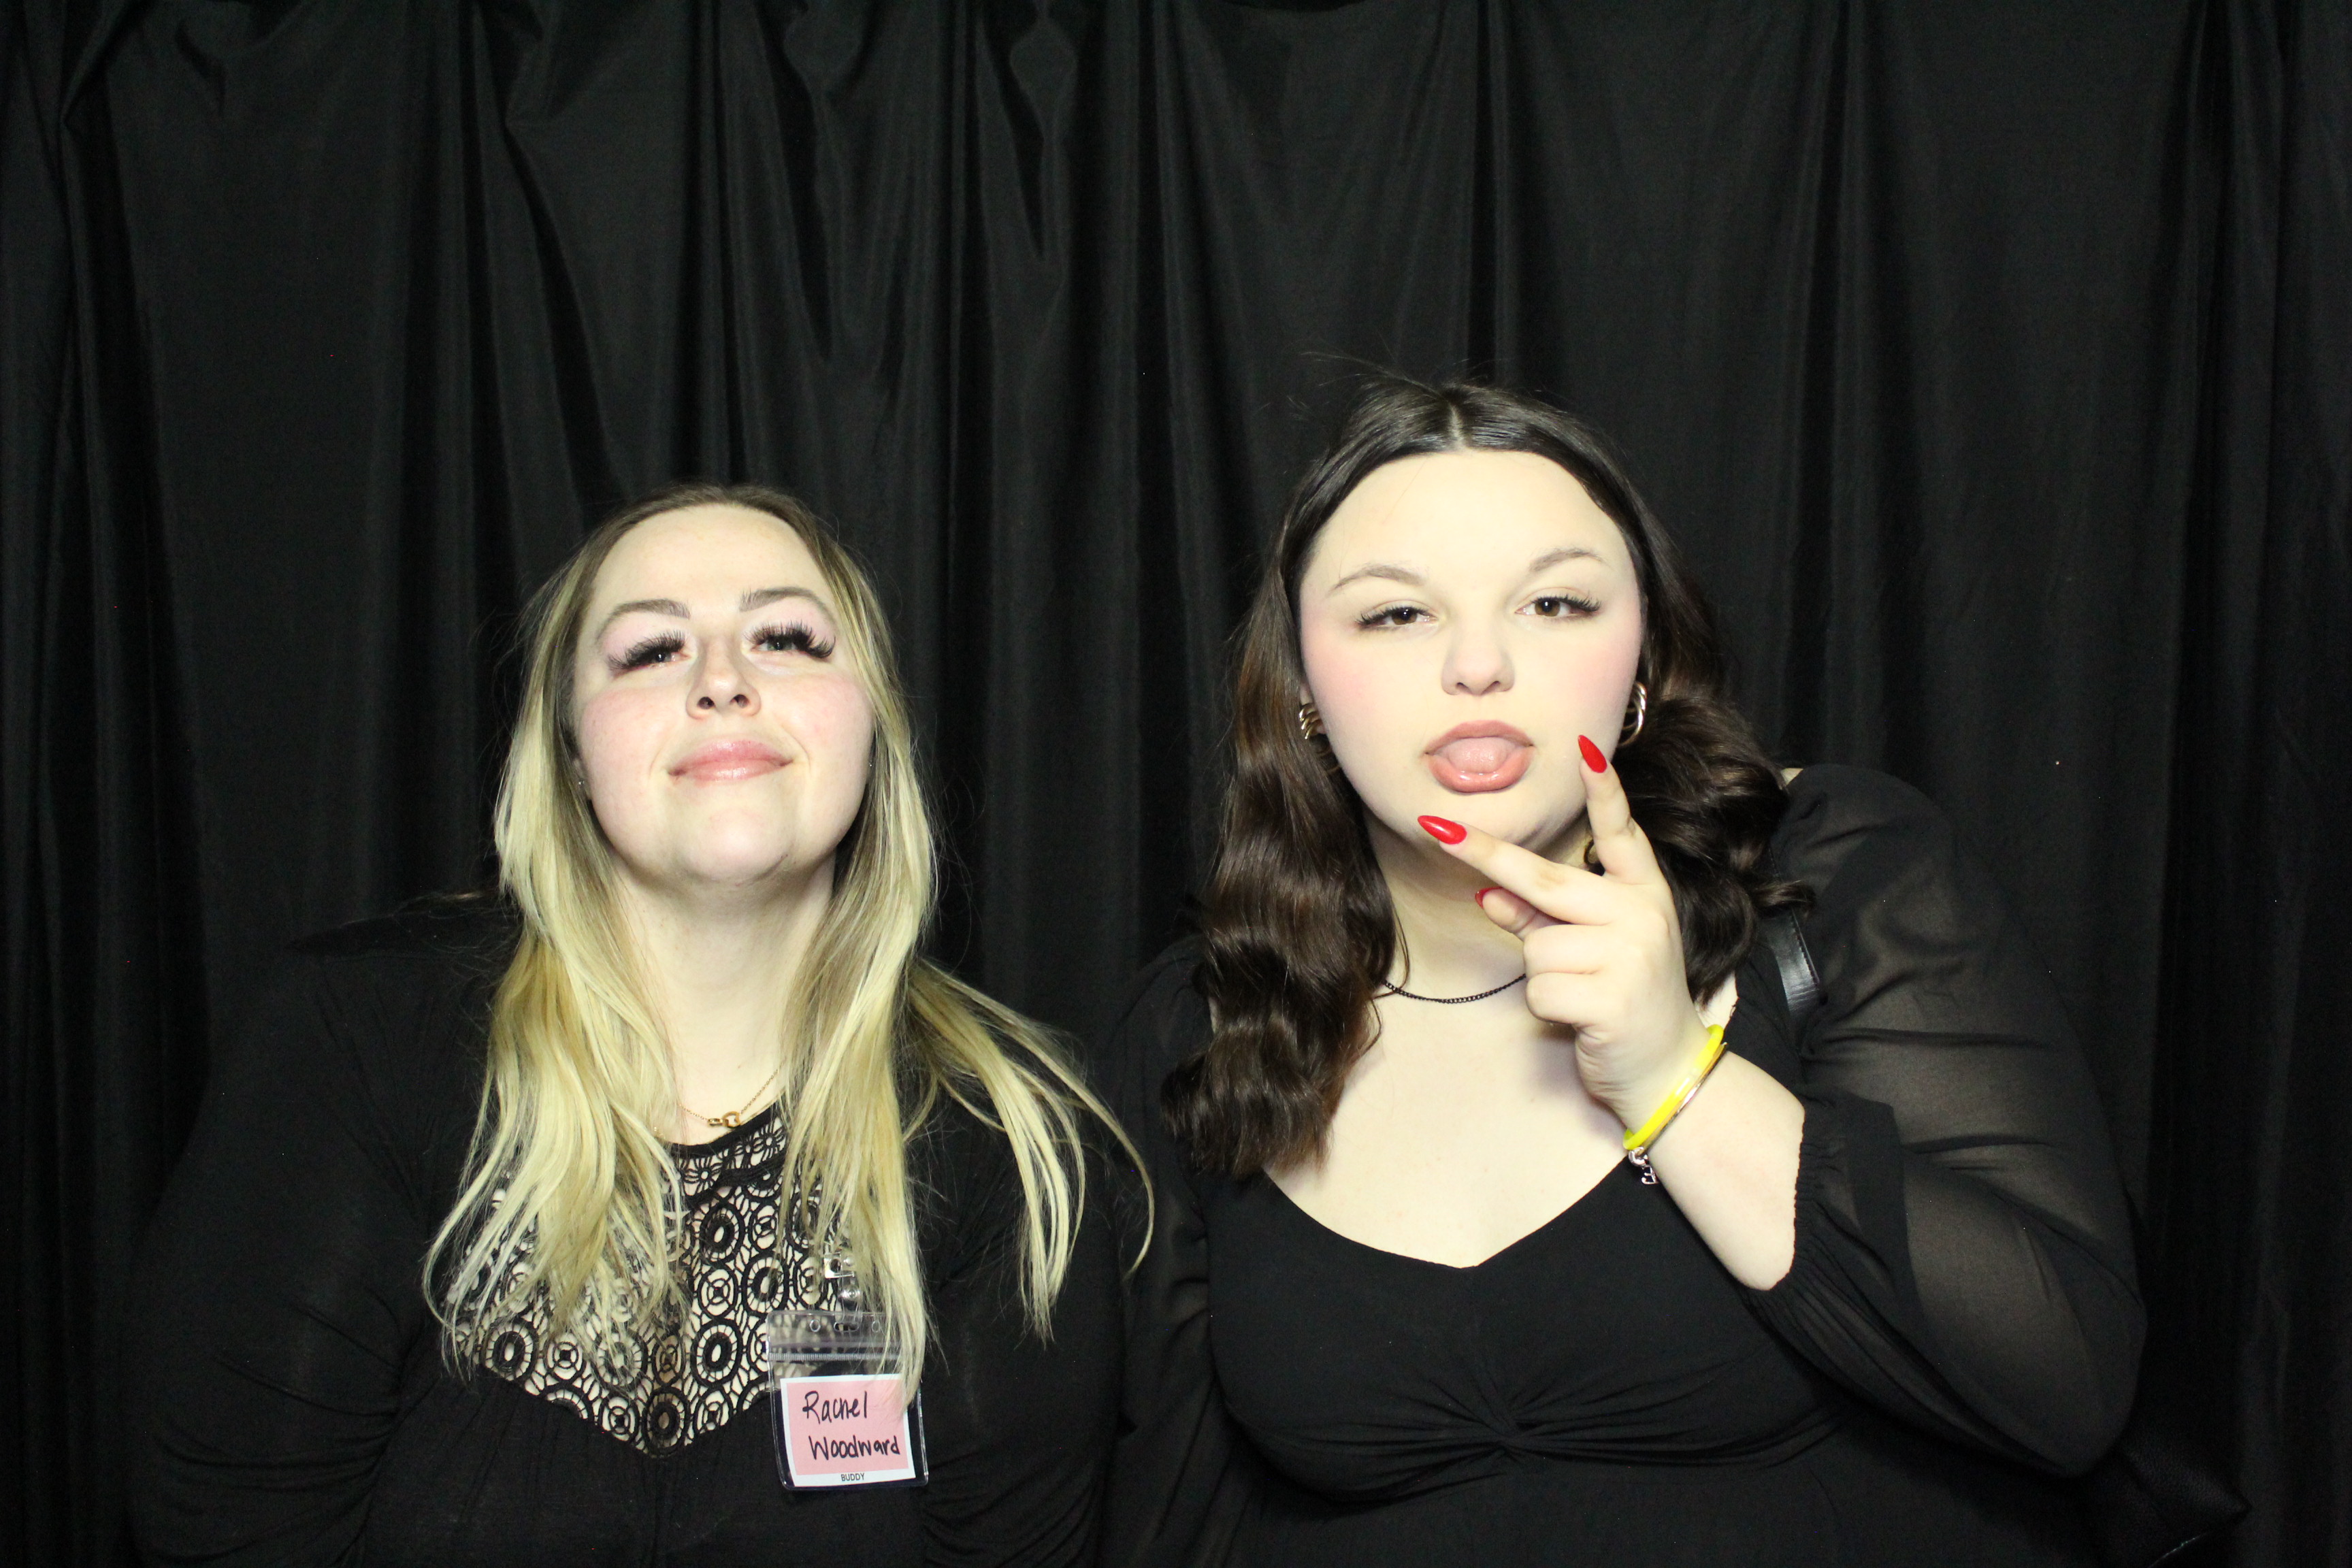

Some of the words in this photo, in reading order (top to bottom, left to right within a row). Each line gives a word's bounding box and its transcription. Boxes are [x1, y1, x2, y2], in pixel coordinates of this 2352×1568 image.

[802, 1390, 868, 1424] Rachel
[808, 1435, 900, 1461] Woodward
[840, 1473, 865, 1482] BUDDY
